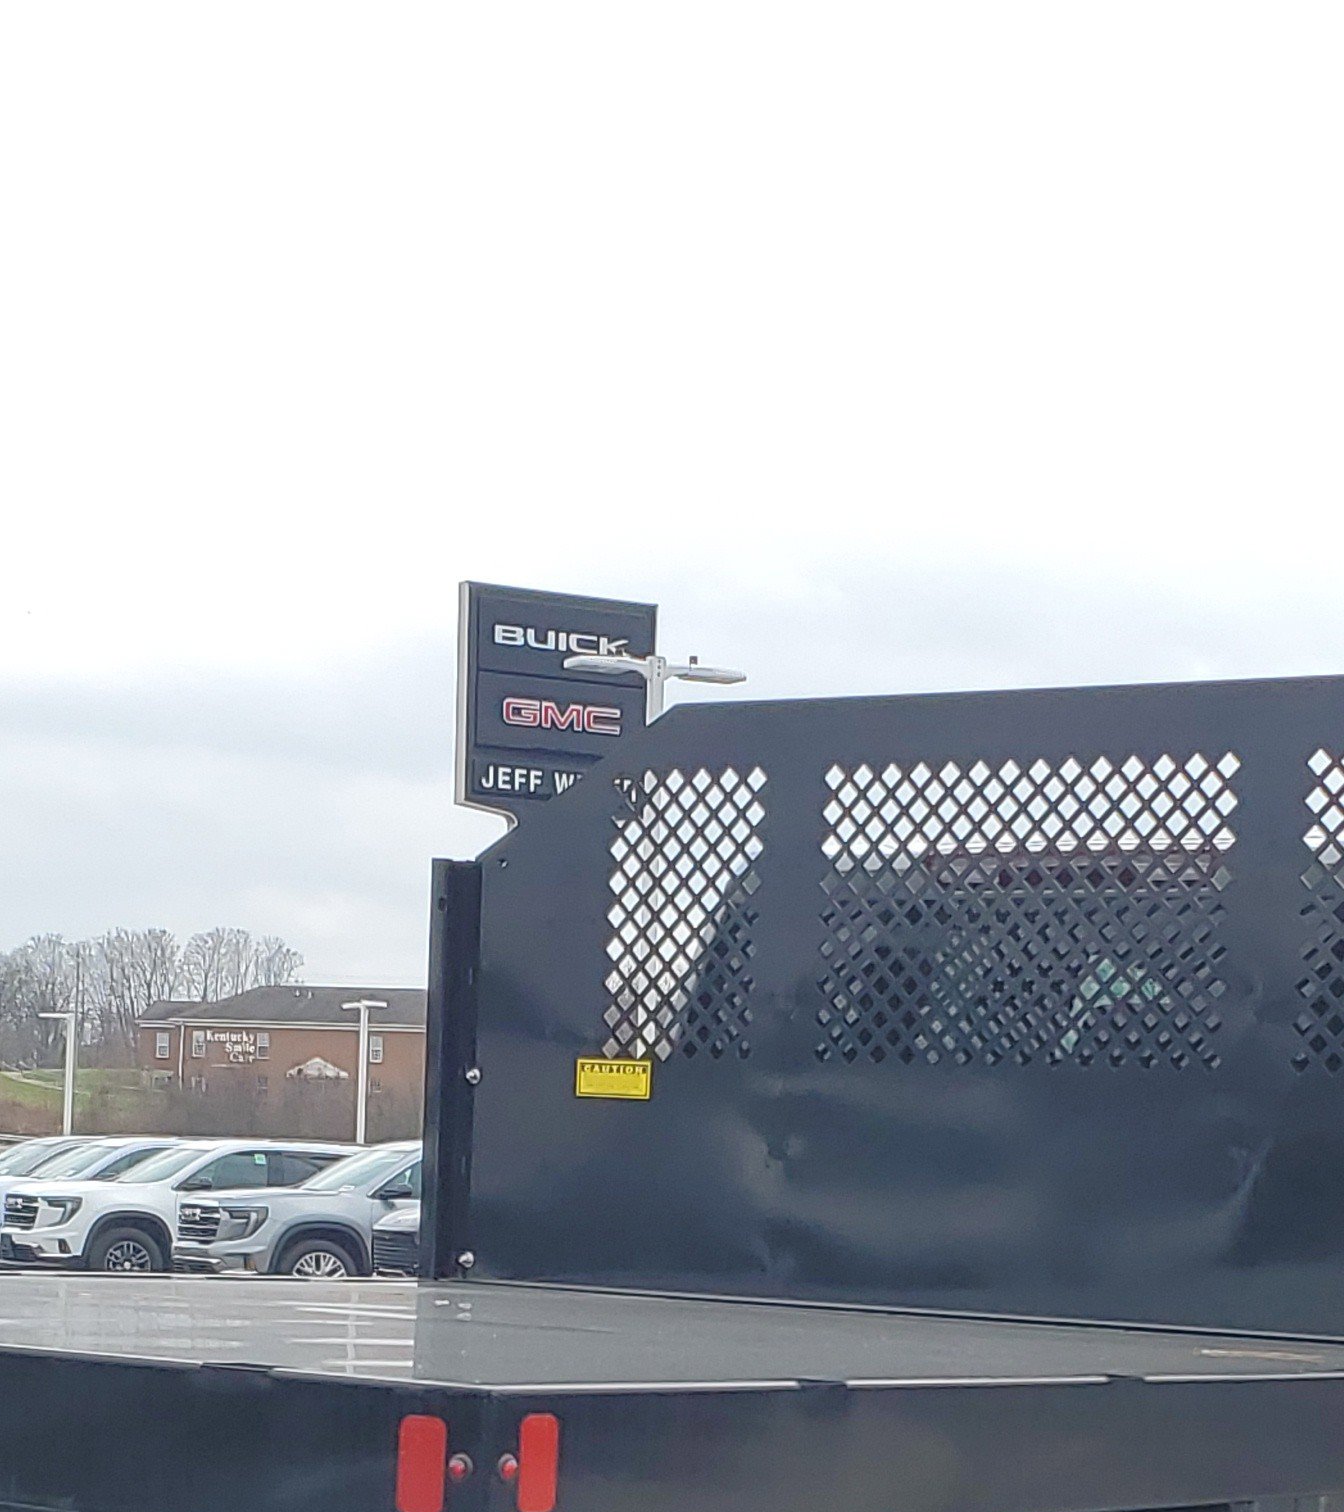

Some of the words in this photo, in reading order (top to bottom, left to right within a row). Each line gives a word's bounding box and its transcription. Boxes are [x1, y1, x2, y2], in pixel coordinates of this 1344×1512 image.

[494, 624, 629, 656] BUICK
[503, 697, 621, 735] GMC
[481, 765, 543, 793] JEFF
[583, 1063, 645, 1075] CAUTION
